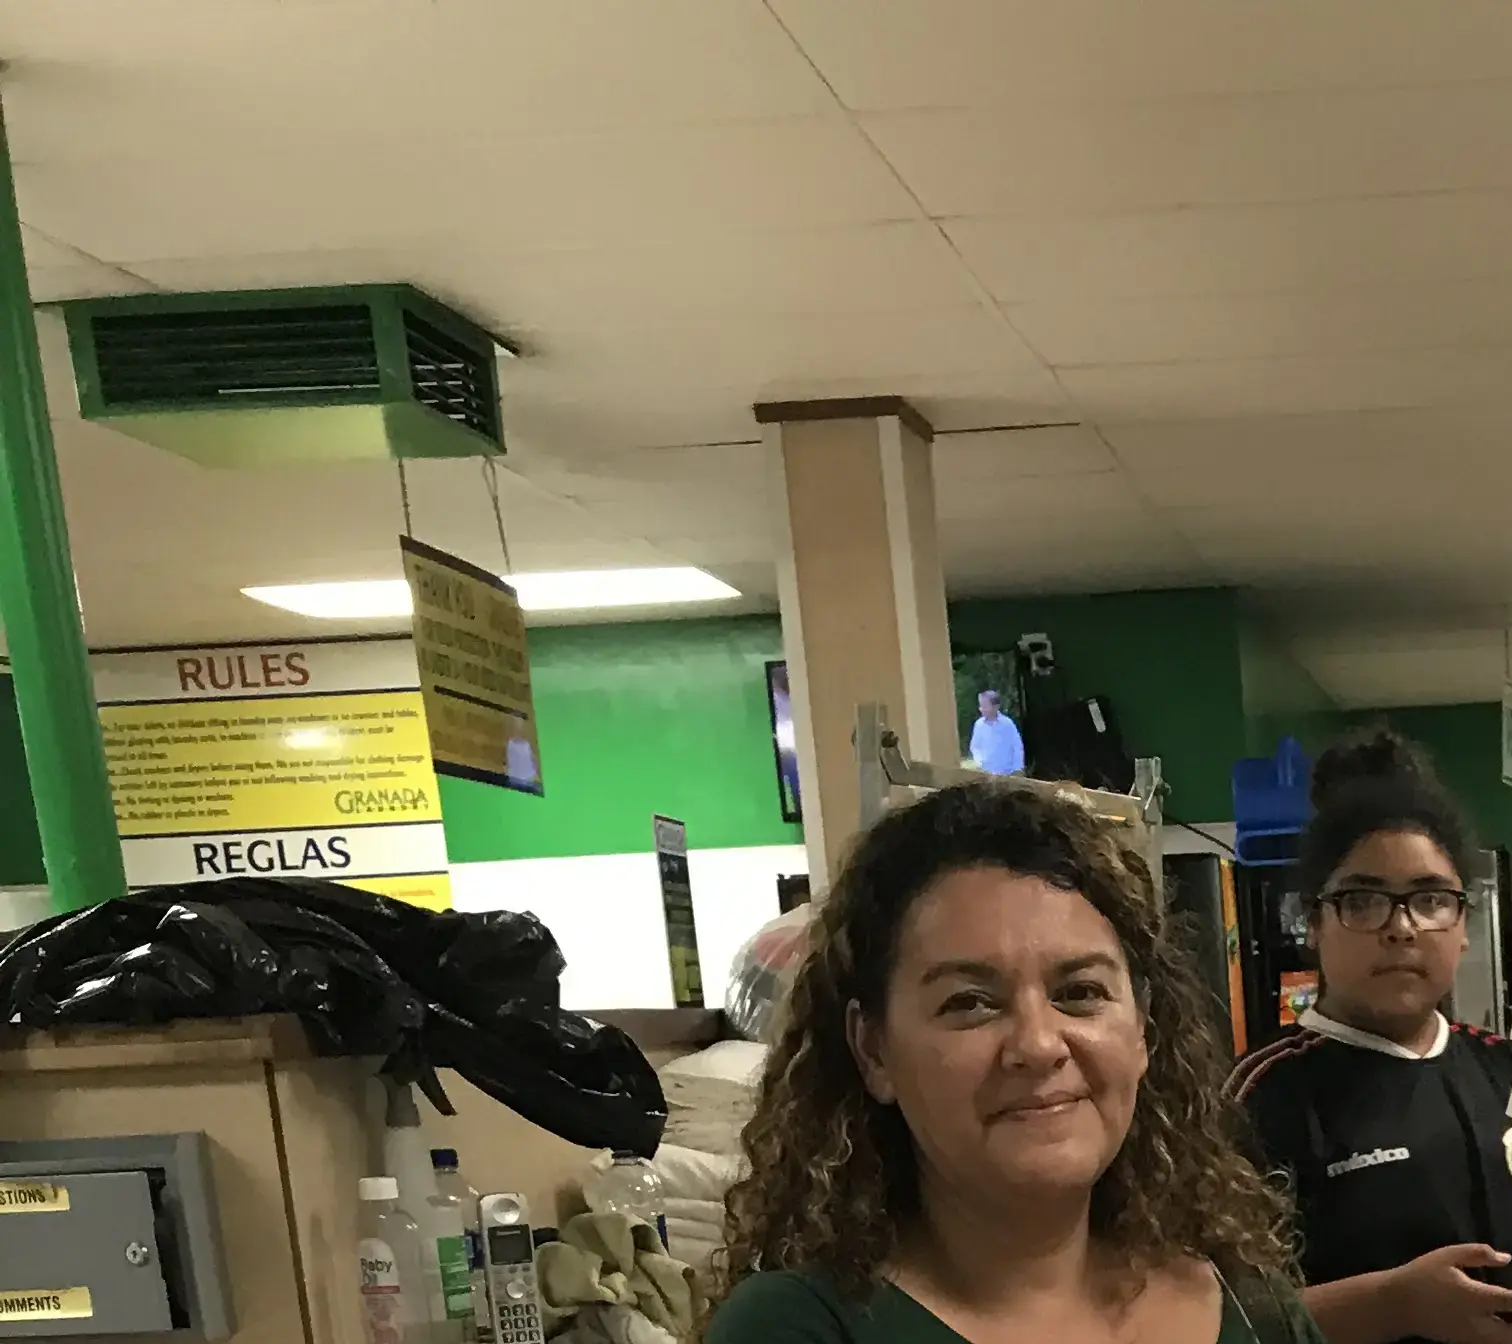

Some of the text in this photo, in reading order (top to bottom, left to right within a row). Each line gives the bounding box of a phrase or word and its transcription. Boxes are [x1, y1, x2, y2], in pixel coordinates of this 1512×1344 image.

[177, 653, 311, 692] RULES
[334, 787, 428, 815] GRANADA
[192, 836, 353, 877] REGLAS
[360, 1257, 393, 1273] Baby
